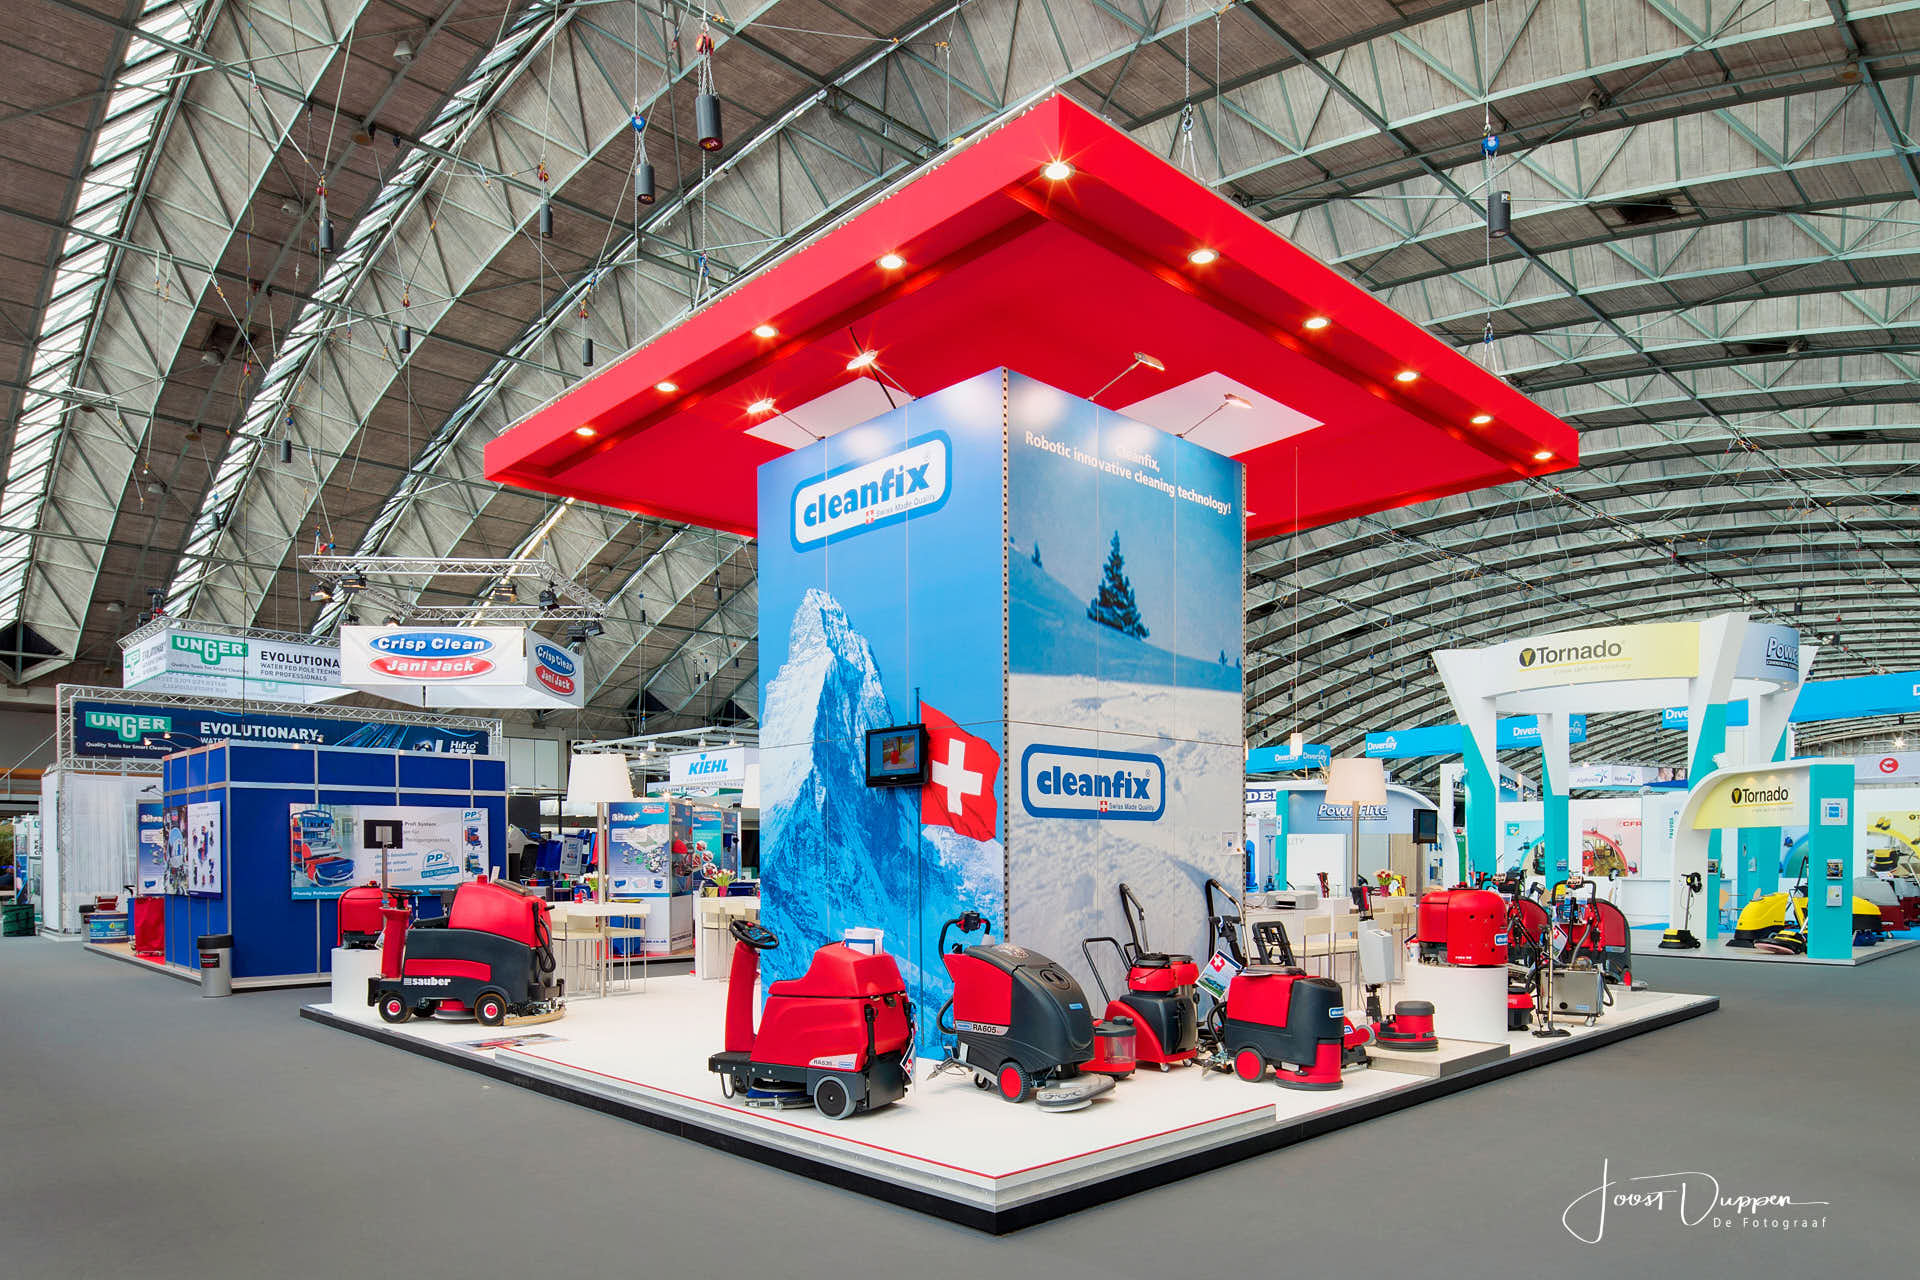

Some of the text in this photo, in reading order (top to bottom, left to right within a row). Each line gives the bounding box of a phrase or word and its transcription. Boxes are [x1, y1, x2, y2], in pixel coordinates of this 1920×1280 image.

[1116, 446, 1160, 472] Cleanfix,
[1025, 431, 1232, 515] Robotic innovative cleaning technology!
[803, 463, 931, 527] cleanfix
[895, 501, 912, 512] Made
[913, 494, 936, 505] Quality
[176, 637, 243, 661] UNGER
[377, 637, 485, 652] Crisp Clean
[1537, 640, 1622, 664] Tornado
[260, 651, 340, 668] EVOLUTIONA
[387, 660, 476, 672] Jani Jack
[537, 646, 574, 672] Crisp Clean
[275, 671, 327, 681] PROFESSIONALS
[541, 667, 571, 690] Jani Jack
[91, 713, 166, 738] UNGER
[200, 721, 319, 741] EVOLUTIONARY
[86, 741, 106, 749] Quality
[1368, 741, 1397, 751] Diversey
[688, 756, 729, 775] KIEHL
[1036, 765, 1151, 800] cleanfix
[1742, 786, 1789, 803] Tornado
[1138, 804, 1155, 812] Quality
[412, 977, 451, 986] sauber
[972, 1024, 997, 1034] RA605
